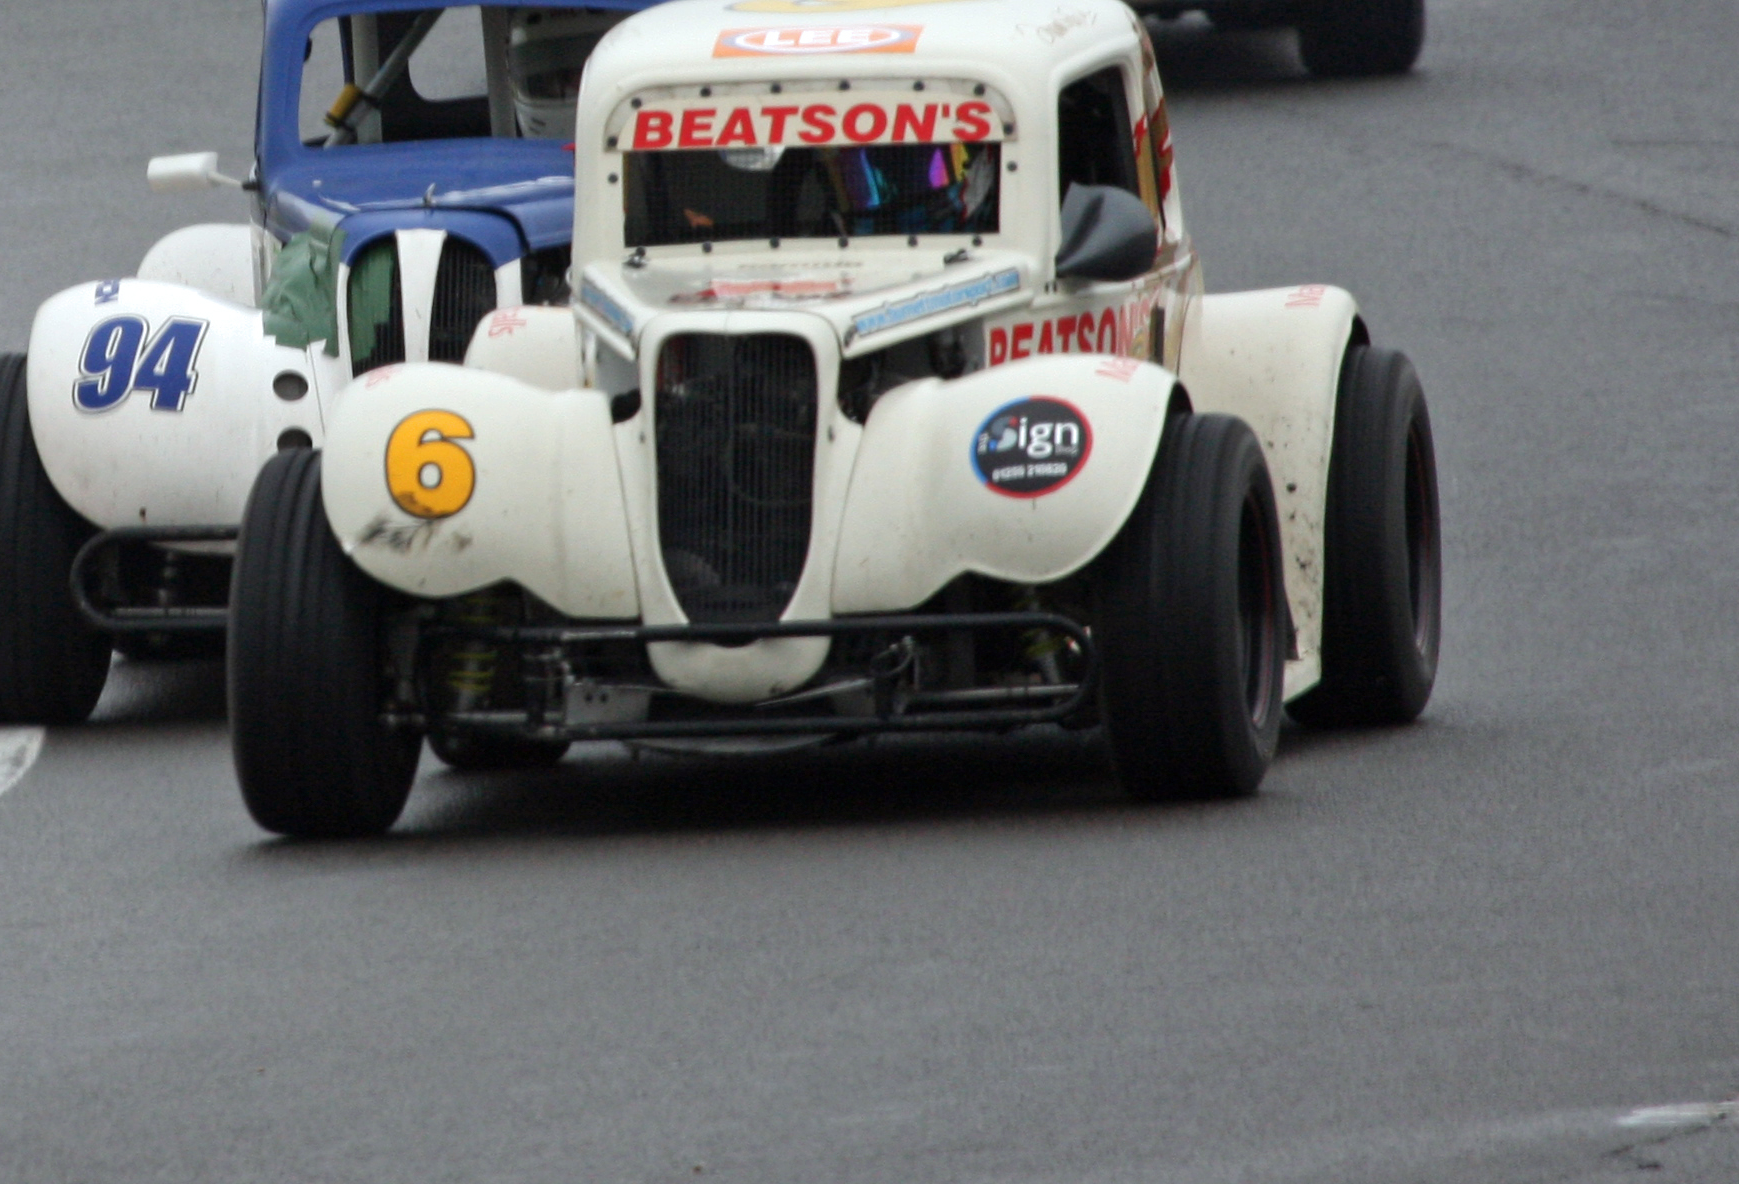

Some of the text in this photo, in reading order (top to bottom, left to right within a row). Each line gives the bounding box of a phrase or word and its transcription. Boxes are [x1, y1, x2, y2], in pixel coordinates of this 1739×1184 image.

[762, 28, 874, 48] LEE
[632, 100, 992, 149] BEATSON'S
[72, 313, 210, 413] 94
[385, 408, 476, 519] 6
